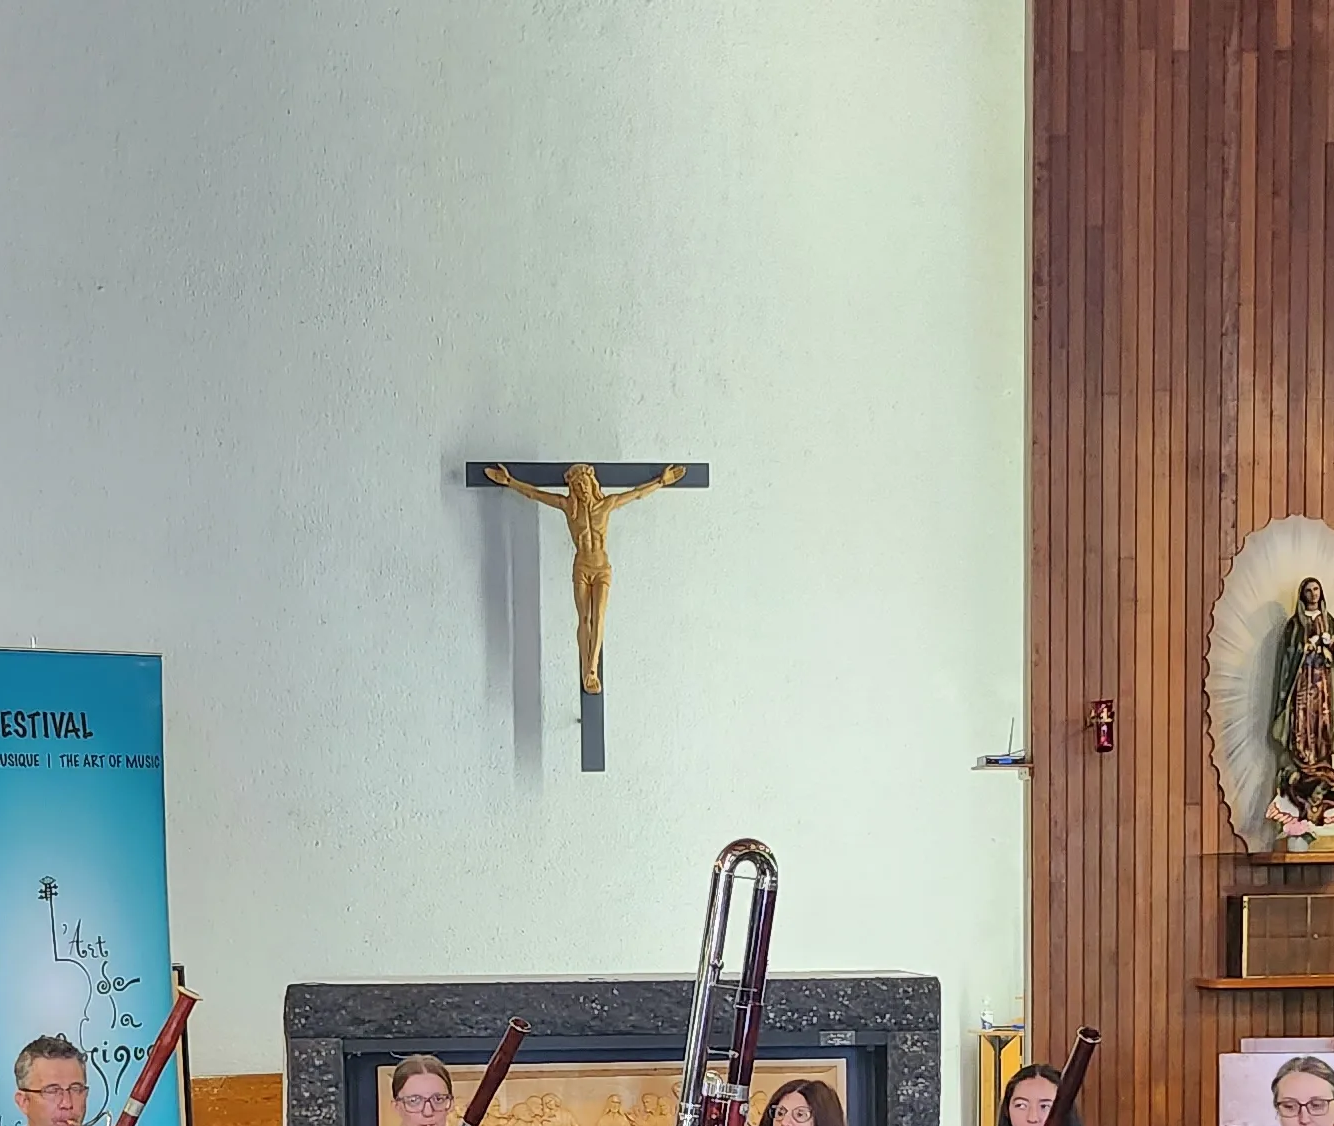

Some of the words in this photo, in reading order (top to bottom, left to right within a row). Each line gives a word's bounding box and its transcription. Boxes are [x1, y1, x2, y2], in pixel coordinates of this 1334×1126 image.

[59, 753, 80, 768] THE
[83, 753, 106, 769] ART
[108, 754, 122, 768] OF
[126, 754, 160, 769] MUSIC
